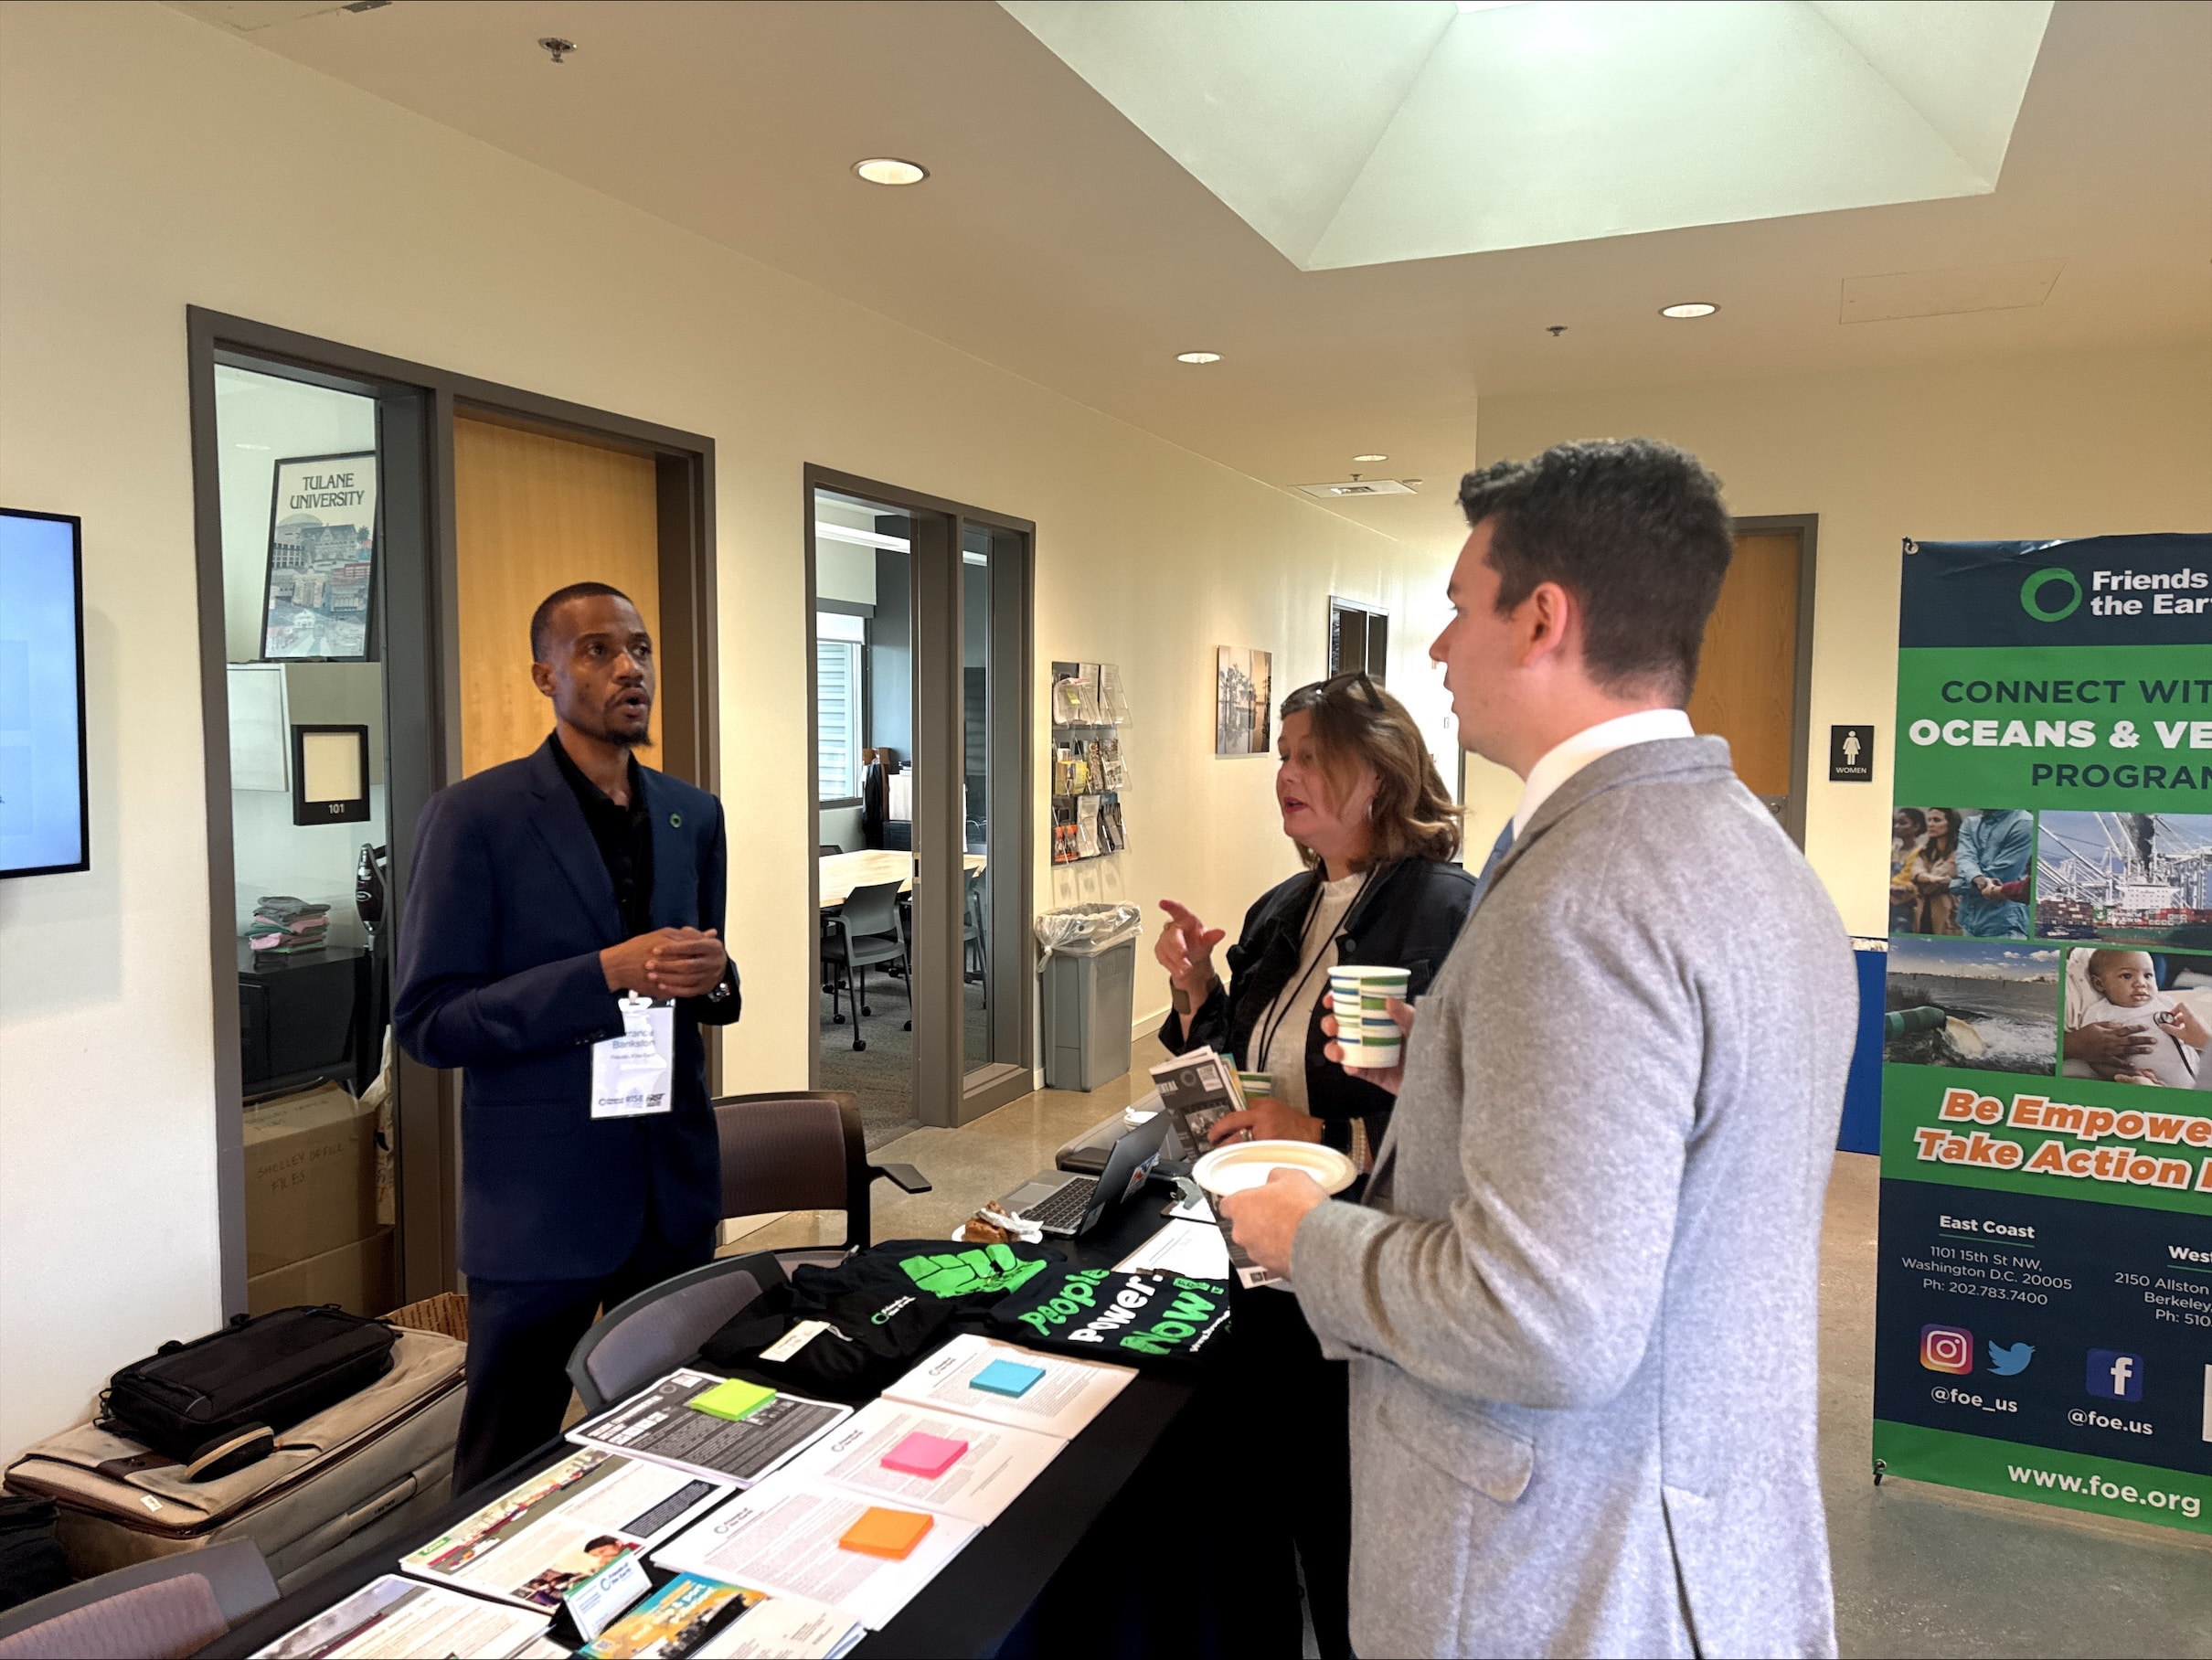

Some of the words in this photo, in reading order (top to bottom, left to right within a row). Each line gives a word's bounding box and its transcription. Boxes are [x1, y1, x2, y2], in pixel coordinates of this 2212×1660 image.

[303, 473, 354, 491] TULANE
[290, 490, 365, 509] UNIVERSITY
[2091, 568, 2209, 591] Friends
[2090, 595, 2143, 616] the
[2153, 593, 2212, 614] Ear
[1941, 680, 2125, 703] CONNECT
[1909, 719, 2096, 747] OCEANS
[2109, 720, 2140, 748] &
[328, 803, 345, 814] 101
[1940, 1089, 2003, 1123] Be
[1915, 1128, 2022, 1168] Take
[2026, 1142, 2191, 1188] Action
[1939, 1215, 1978, 1231] East
[1983, 1220, 2035, 1239] Coast
[1930, 1246, 1956, 1259] 1101
[1960, 1250, 1988, 1263] 15th
[1993, 1254, 2008, 1266] St
[2013, 1257, 2043, 1272] NW,
[1901, 1257, 1985, 1278] Washington
[1989, 1269, 2018, 1282] D.C.
[2022, 1273, 2072, 1290] 20005
[2114, 1272, 2150, 1286] 2150
[2154, 1278, 2210, 1294] Allston
[1923, 1278, 1945, 1291] Ph:
[1949, 1282, 2047, 1305] 202.783.7400
[2155, 1309, 2180, 1323] Ph:
[1930, 1386, 2018, 1412] @foe_us
[2068, 1409, 2154, 1435] @foe.us
[2007, 1464, 2202, 1517] www.foe.org
